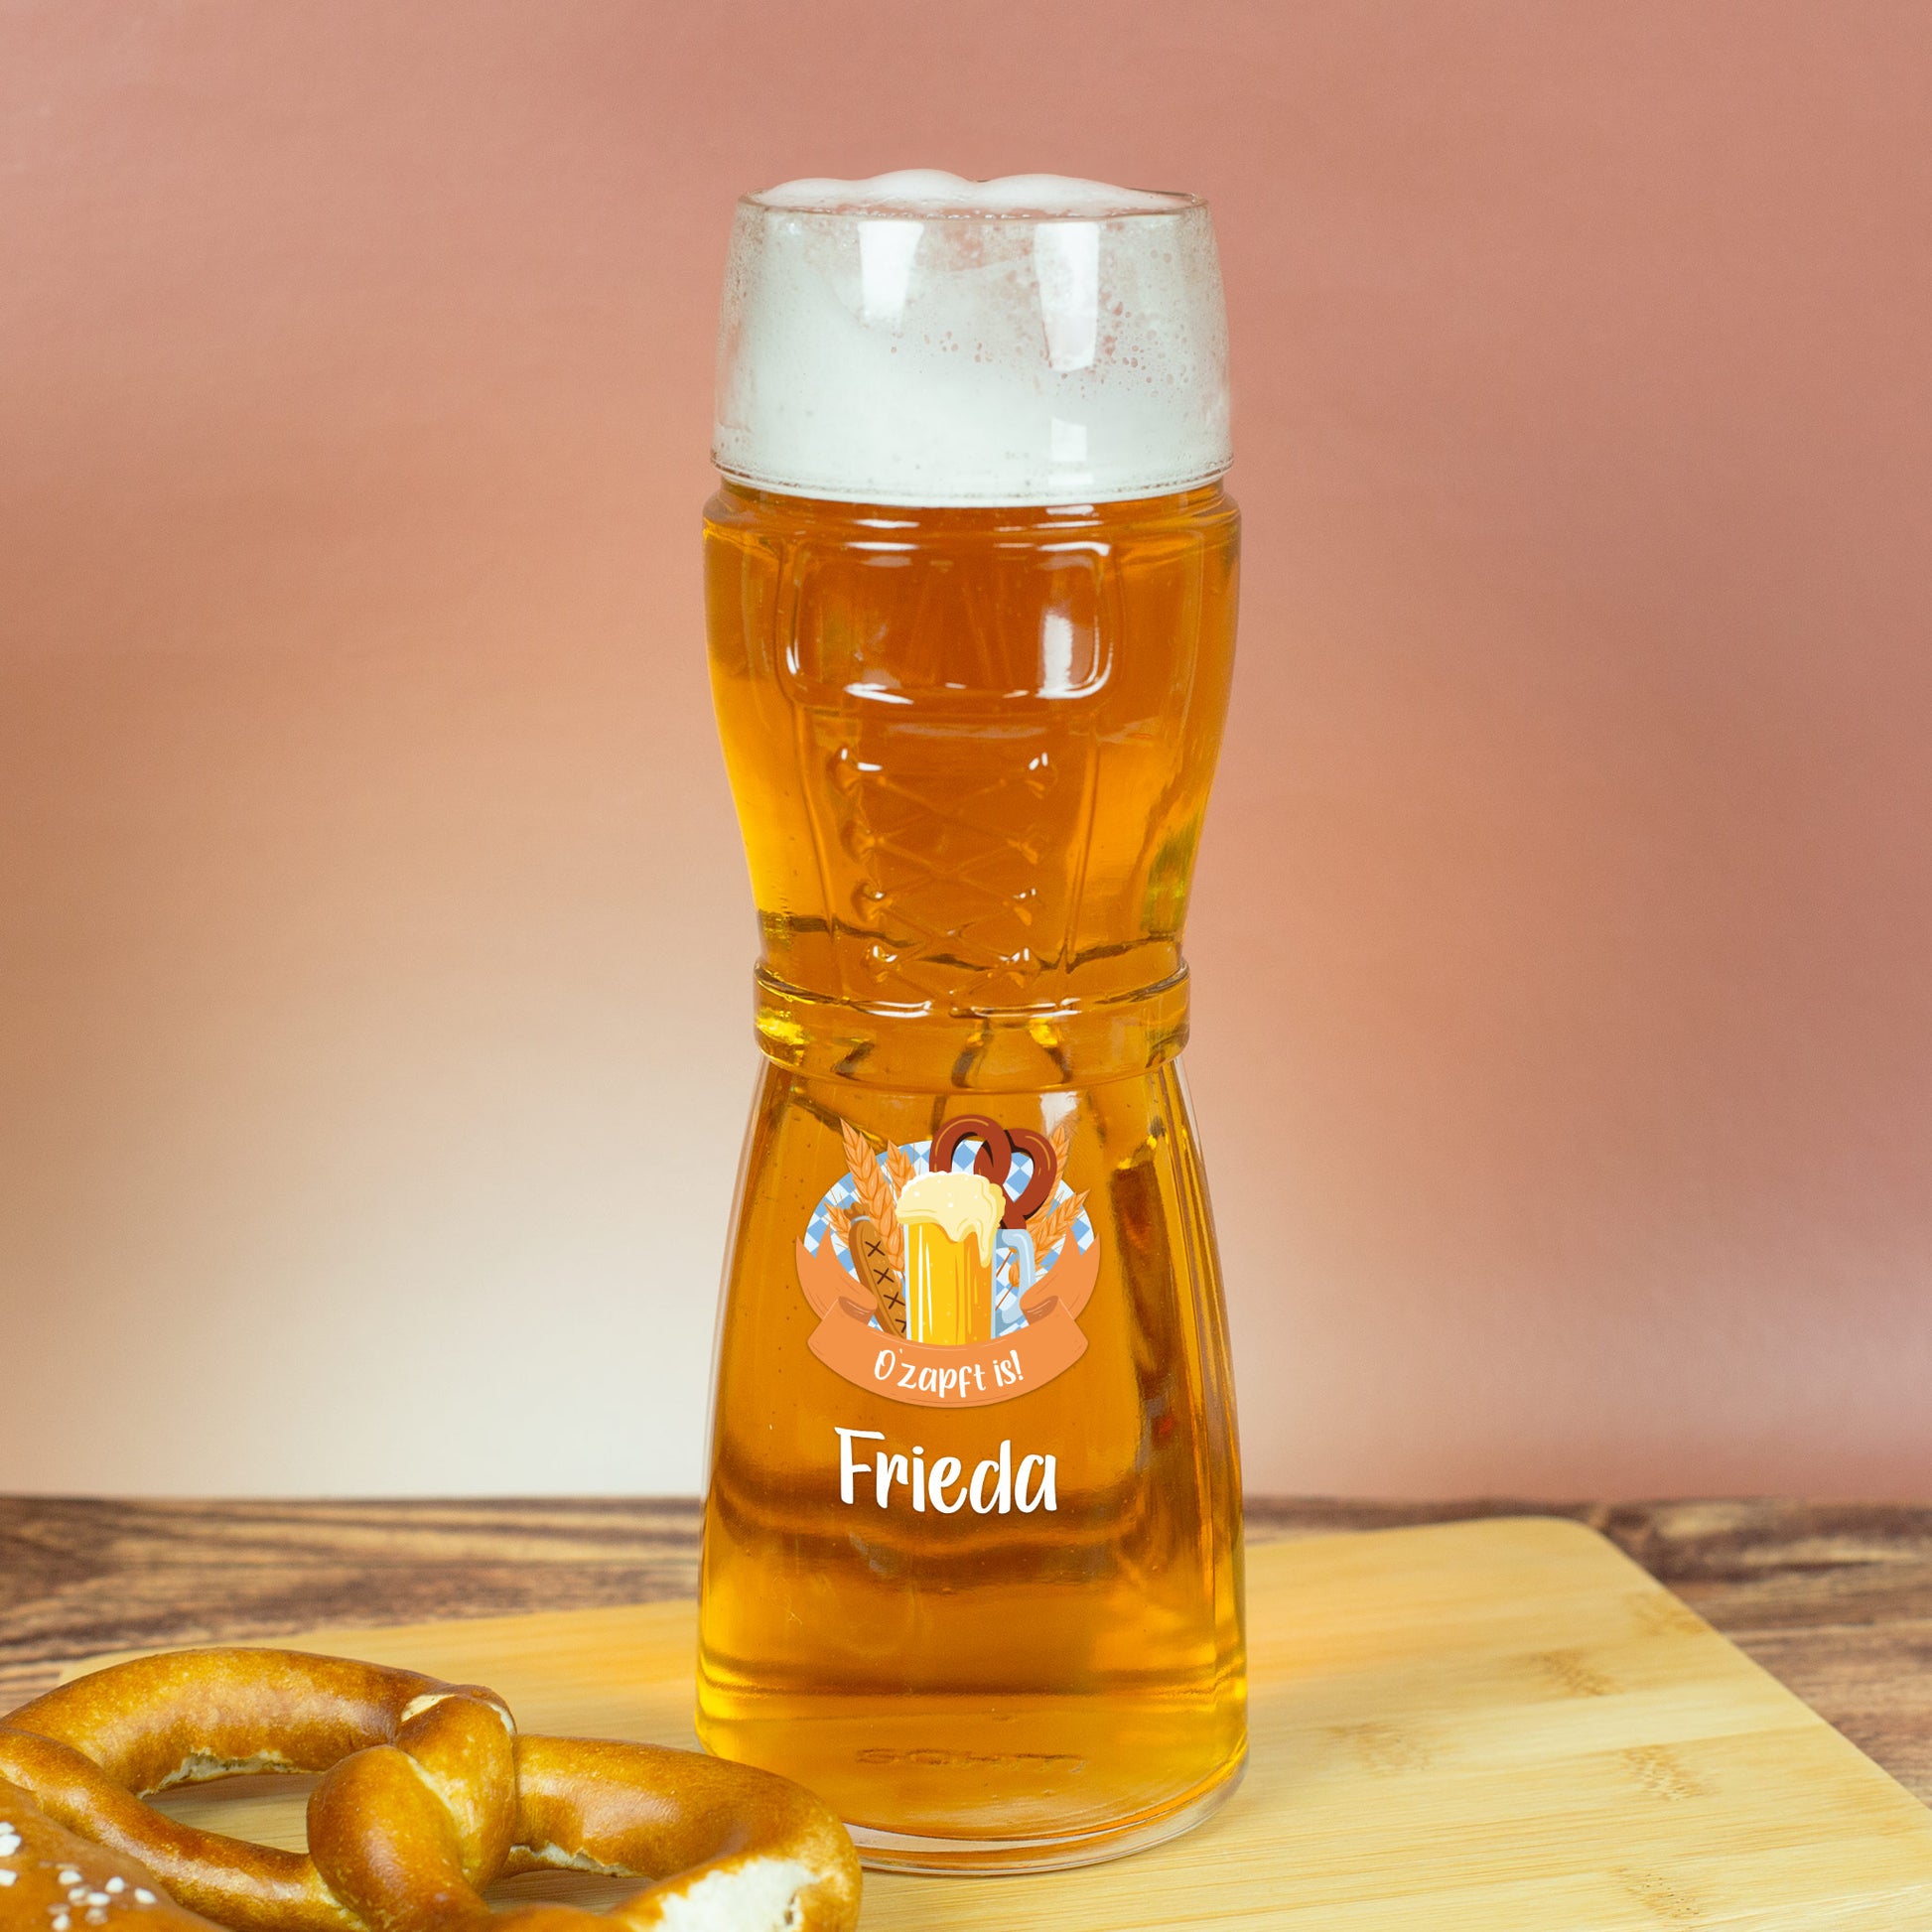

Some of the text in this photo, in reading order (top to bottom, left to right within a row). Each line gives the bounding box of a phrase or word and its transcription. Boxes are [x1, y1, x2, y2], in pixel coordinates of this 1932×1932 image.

[875, 1348, 1024, 1398] O'zapft is!
[835, 1427, 1057, 1514] Frieda
